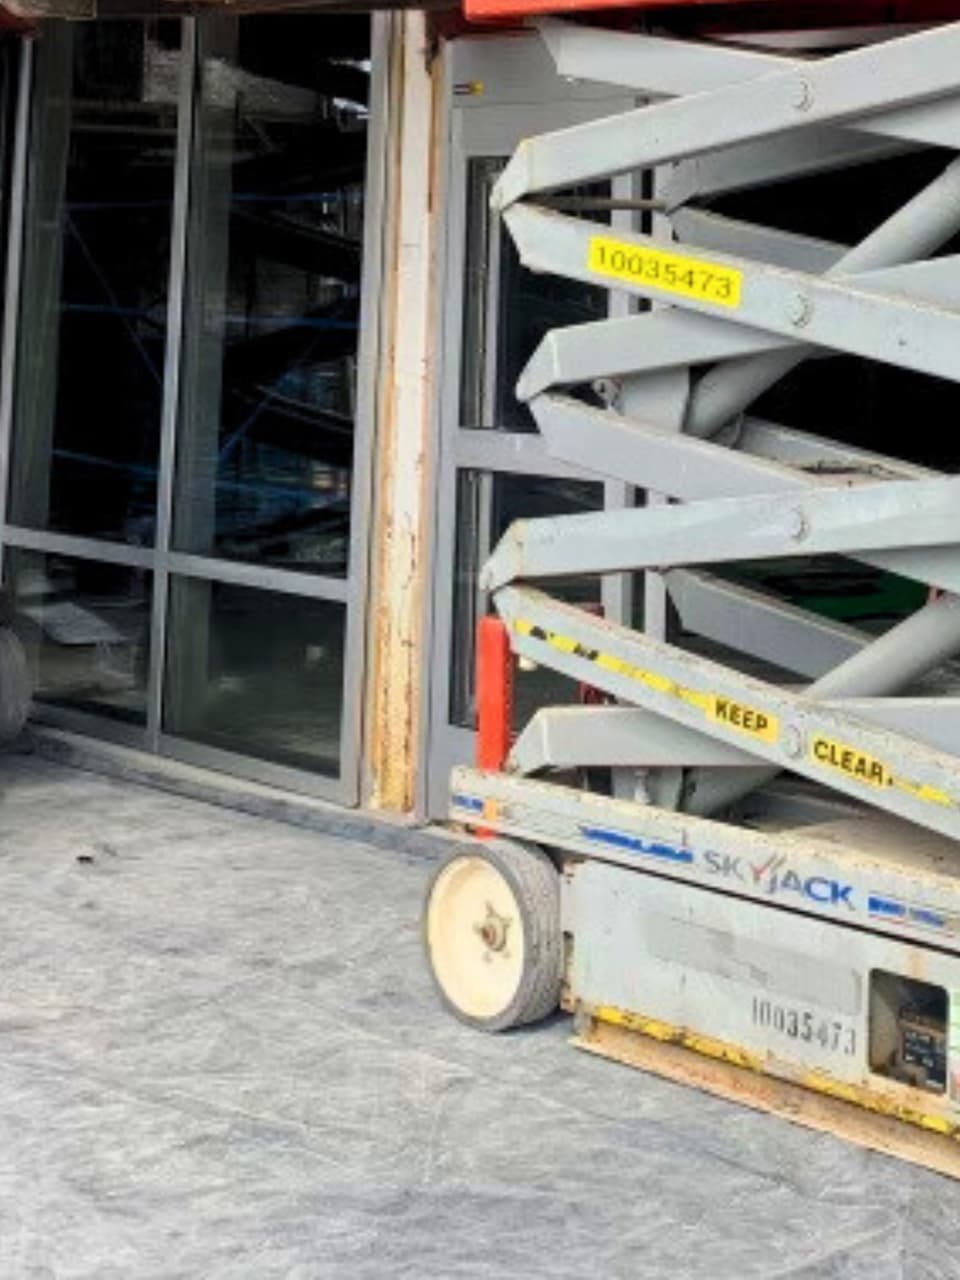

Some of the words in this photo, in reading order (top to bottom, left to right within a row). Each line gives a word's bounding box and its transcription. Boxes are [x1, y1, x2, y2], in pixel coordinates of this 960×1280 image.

[597, 245, 733, 299] 10035473
[714, 698, 769, 733] KEEP
[703, 850, 856, 911] SKYJACK
[752, 996, 856, 1056] 10035473
